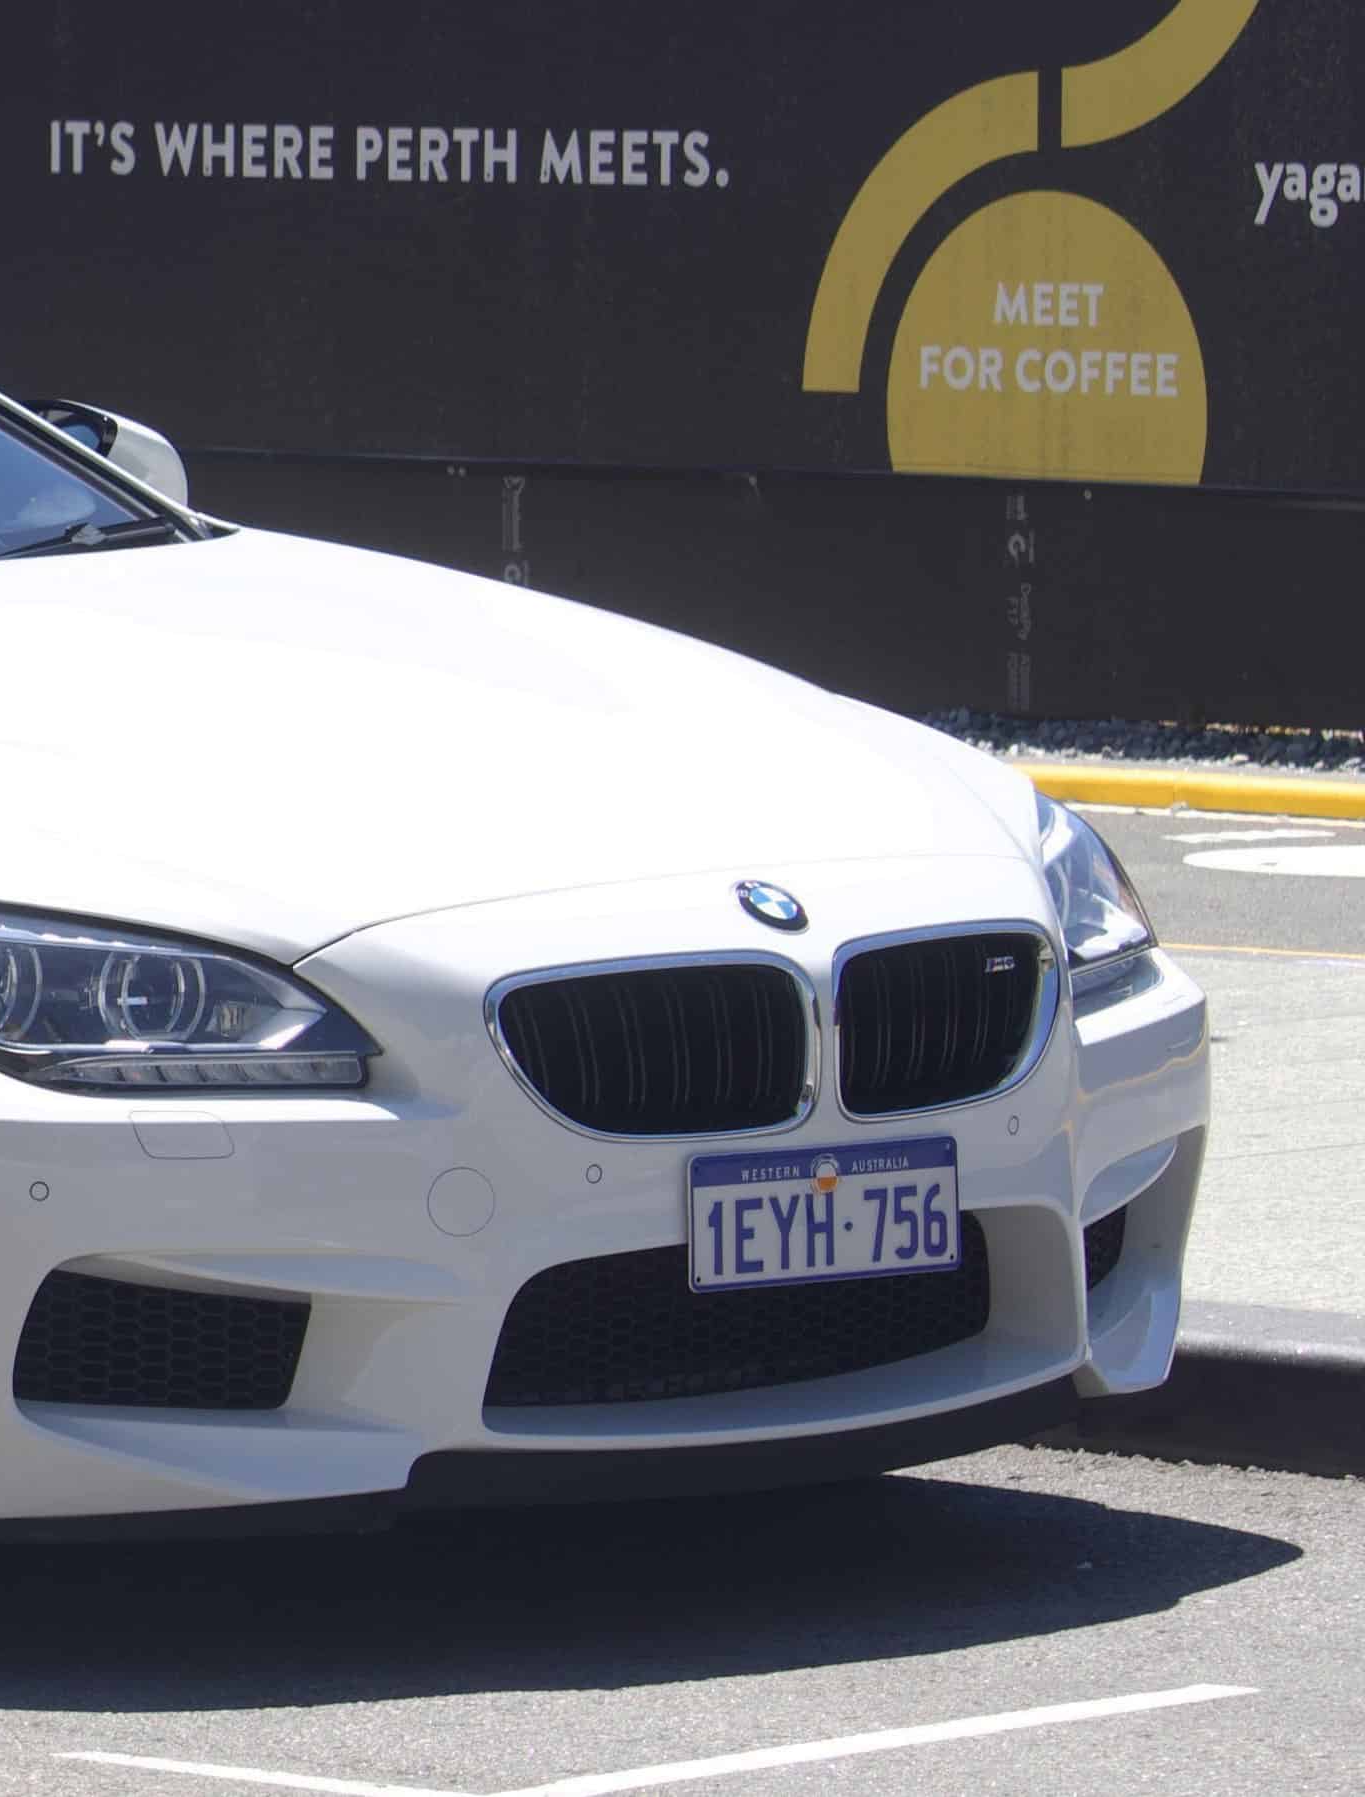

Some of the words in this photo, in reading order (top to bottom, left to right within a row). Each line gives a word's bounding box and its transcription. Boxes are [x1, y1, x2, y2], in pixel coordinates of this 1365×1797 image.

[155, 122, 335, 180] WHERE
[356, 127, 517, 183] PERTH
[539, 129, 730, 187] MEETS.
[1254, 162, 1365, 228] yaga
[994, 282, 1104, 327] MEET
[920, 345, 1003, 391] FOR
[1016, 350, 1179, 397] COFFEE
[741, 1165, 800, 1182] WESTERN
[852, 1156, 910, 1173] AUSTRALIA
